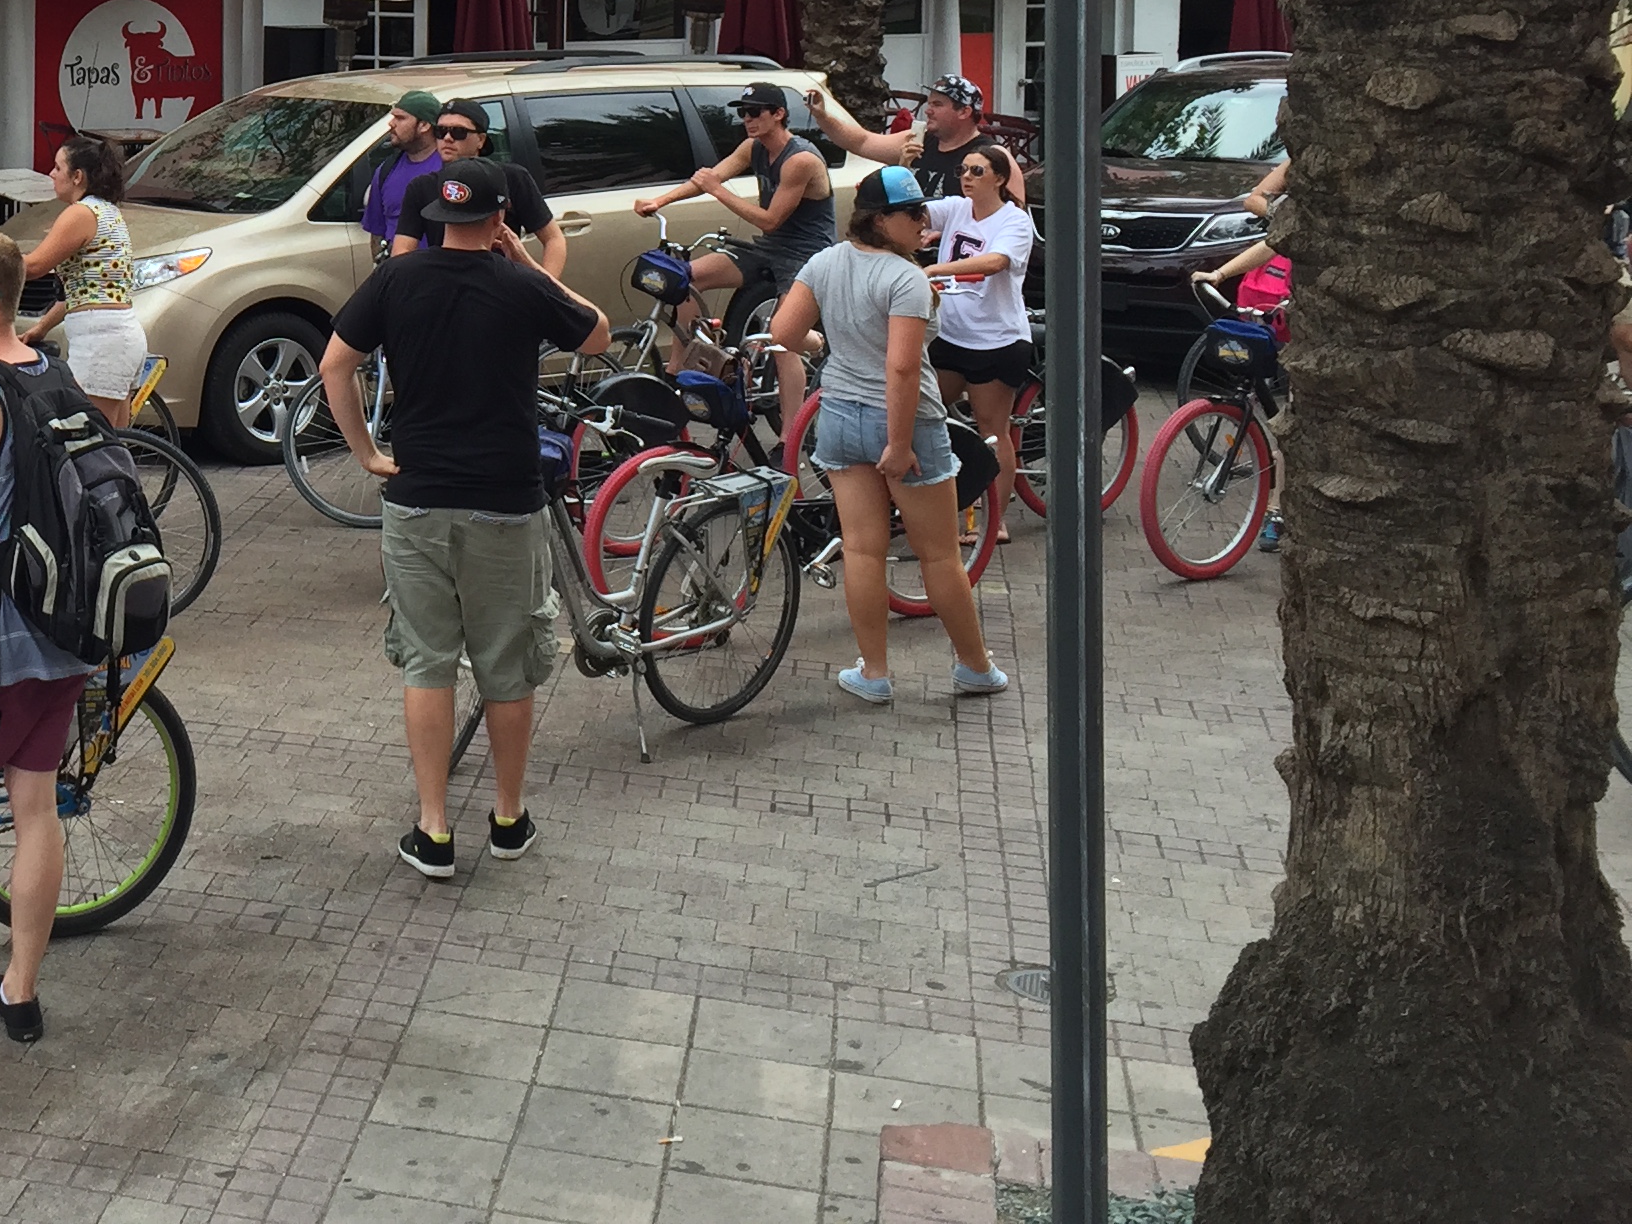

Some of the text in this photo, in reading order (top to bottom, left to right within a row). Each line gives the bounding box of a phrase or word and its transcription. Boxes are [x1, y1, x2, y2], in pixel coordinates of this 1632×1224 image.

[65, 55, 212, 88] Tapas & Tintos
